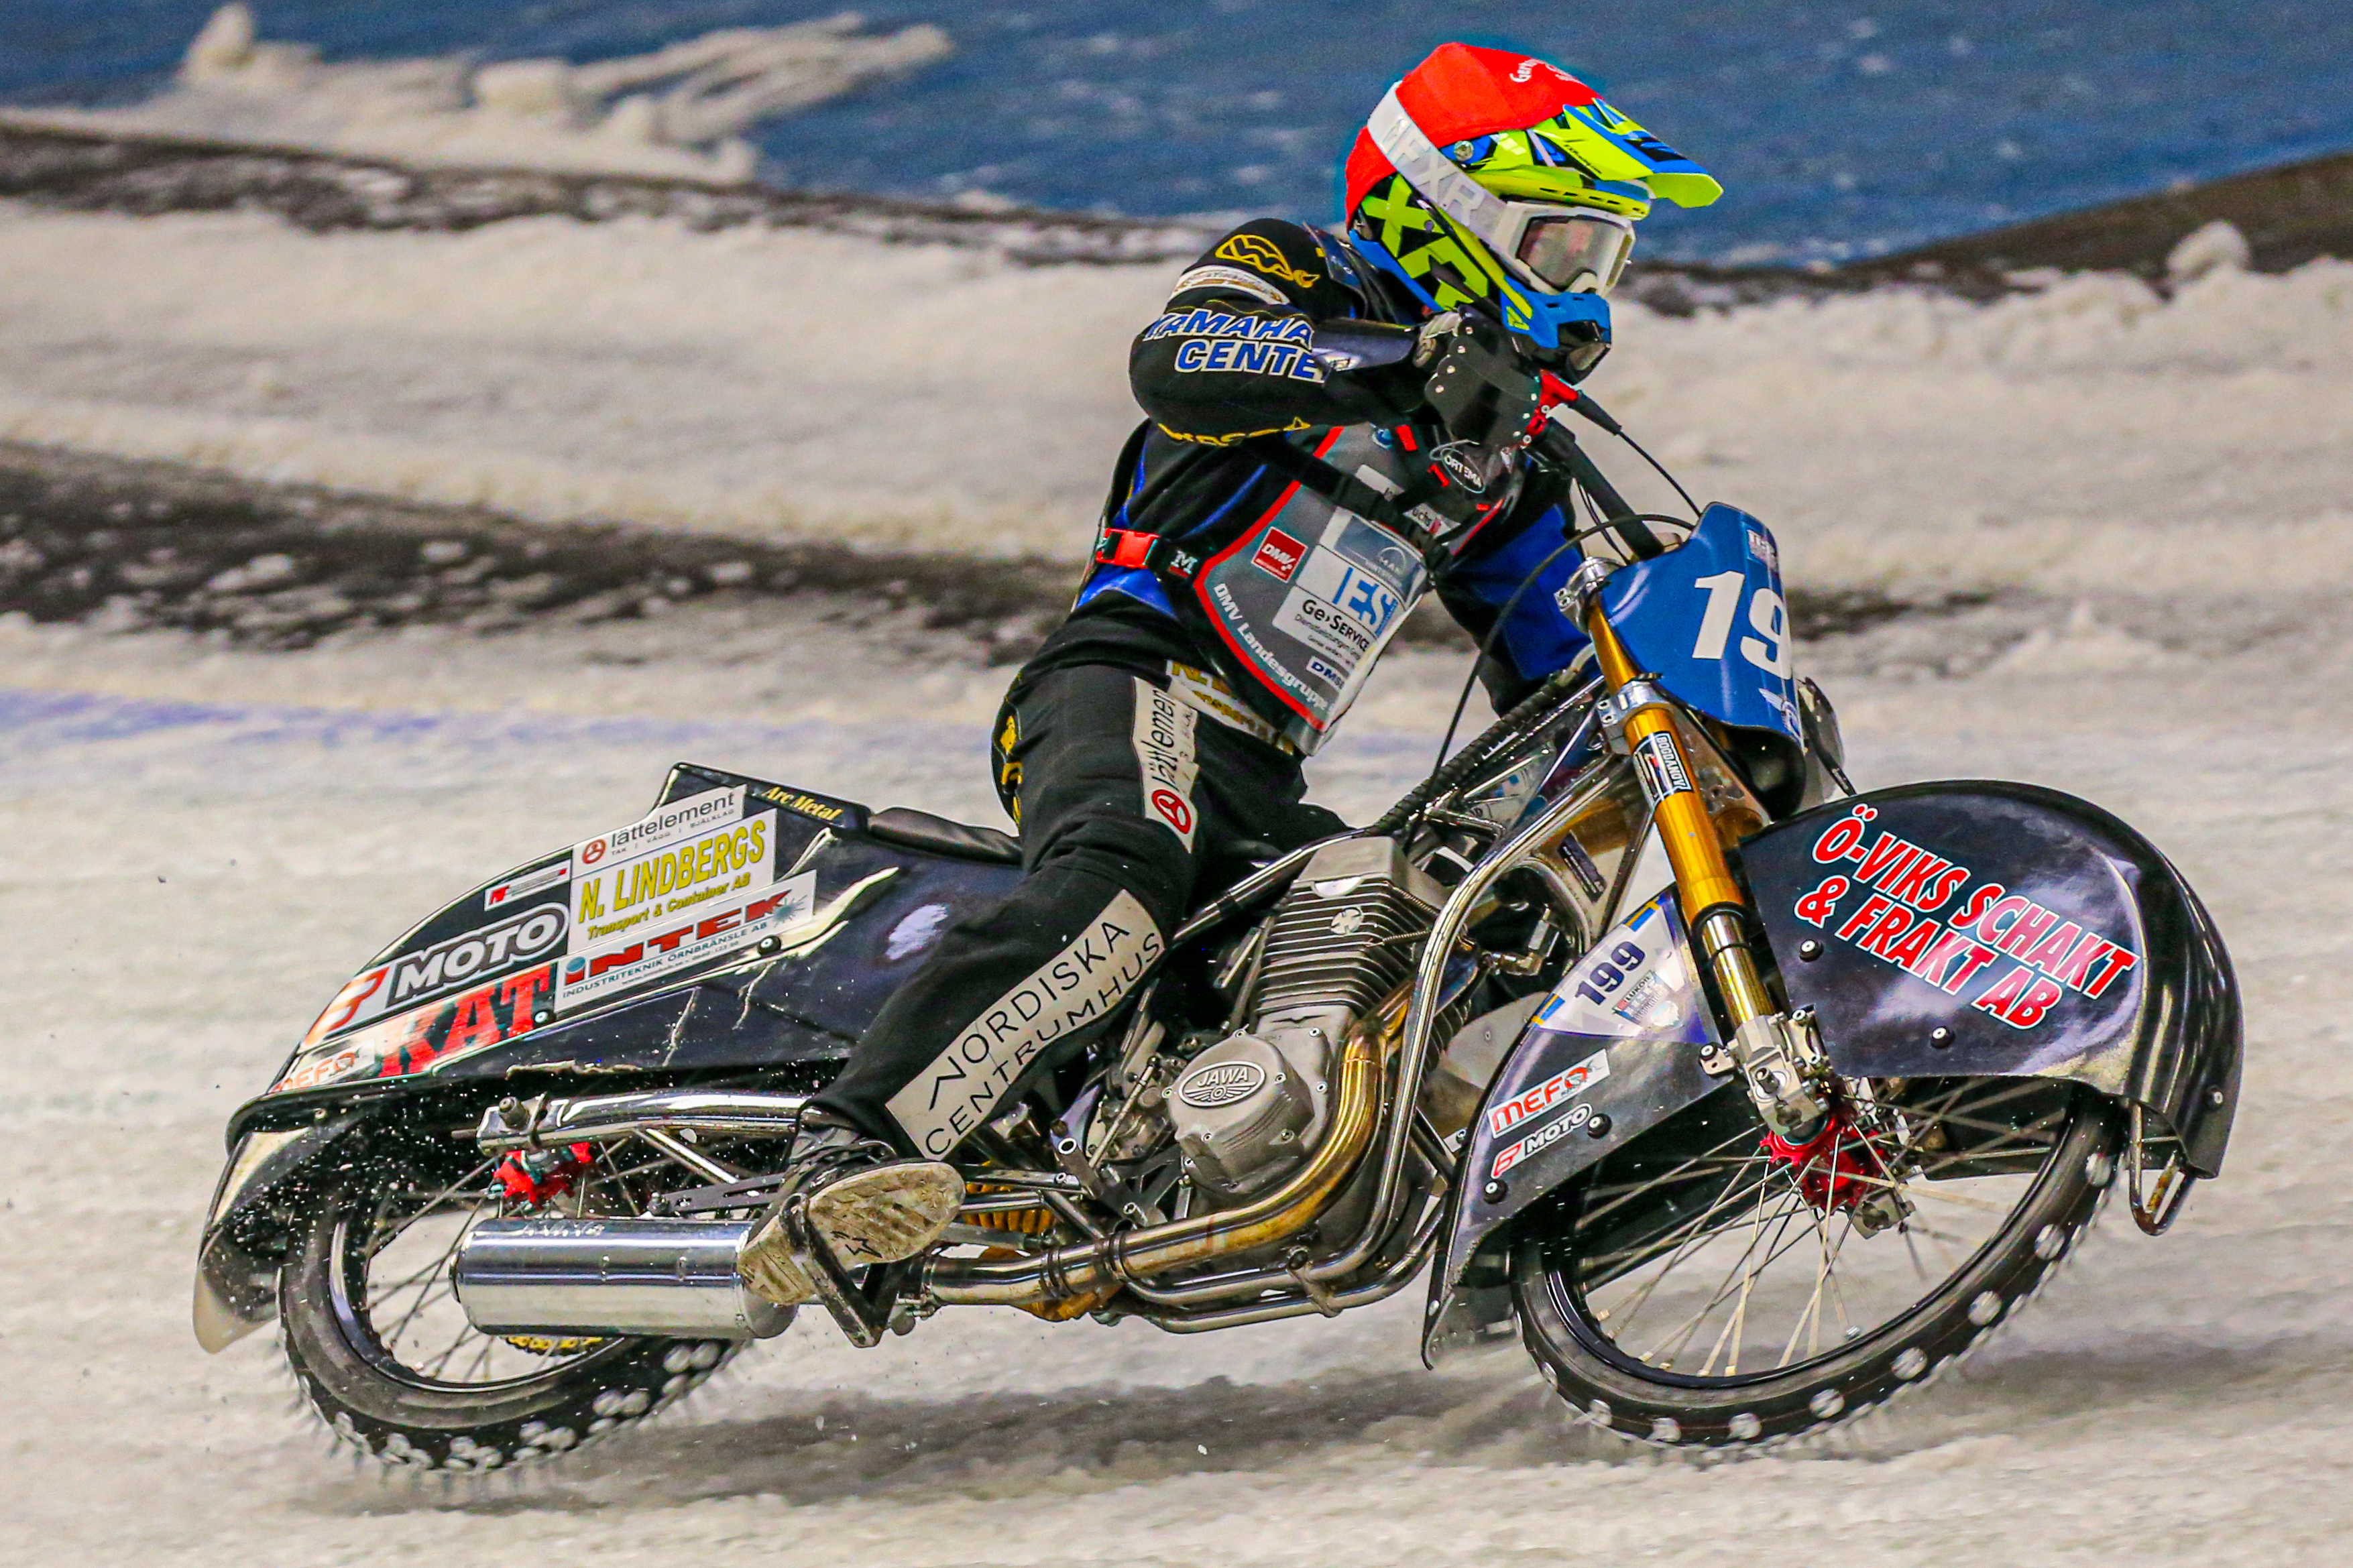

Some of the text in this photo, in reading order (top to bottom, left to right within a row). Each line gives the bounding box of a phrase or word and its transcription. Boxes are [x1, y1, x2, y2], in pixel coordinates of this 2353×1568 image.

[1143, 308, 1314, 350] YAMAHA
[1175, 339, 1326, 383] CENTE
[1443, 454, 1482, 488] ORTEMA
[1214, 583, 1243, 621] DMV
[1141, 689, 1180, 792] lättelemen
[1656, 736, 1686, 787] BOGDANOV
[612, 792, 734, 847] lättelement
[578, 878, 604, 923] N.
[613, 819, 766, 911] LINDBERGS
[1812, 803, 2139, 1000] Ö-VIKS SCHAKT
[587, 872, 751, 940] Transport & Container AB
[396, 914, 558, 998] MOTO
[563, 959, 663, 998] INDUSTRITEKNIK
[751, 922, 768, 932] AB
[1574, 941, 1647, 1005] 199
[1794, 874, 2063, 1030] & FRAKT AB
[930, 920, 1130, 1110] NORDISKA
[1625, 977, 1650, 1001] LUKOIL
[925, 932, 1161, 1157] CENTRUMHUS
[1197, 1067, 1249, 1086] JAWA
[1492, 1067, 1588, 1132] MEFO
[1527, 1107, 1588, 1154] MOTO
